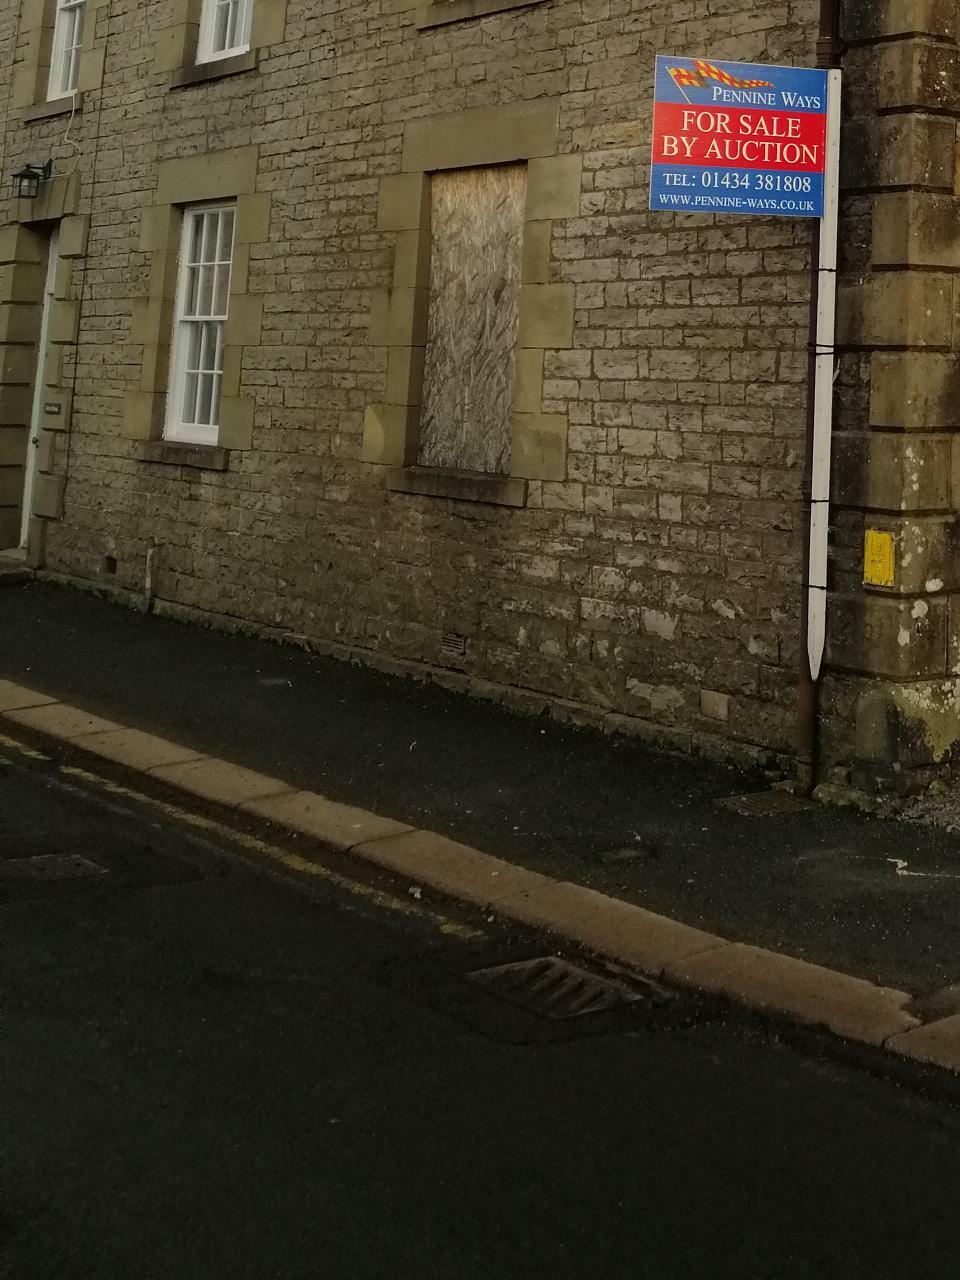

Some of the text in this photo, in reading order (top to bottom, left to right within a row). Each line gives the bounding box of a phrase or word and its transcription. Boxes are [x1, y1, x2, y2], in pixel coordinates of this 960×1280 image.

[712, 86, 821, 109] PENNINE WAYS
[681, 110, 801, 138] FOR SALE
[661, 135, 819, 165] BY AUCTION
[663, 171, 811, 193] TEL: 01434 381808
[659, 193, 815, 211] WWW.PENNINE-WAYS.CO.UK
